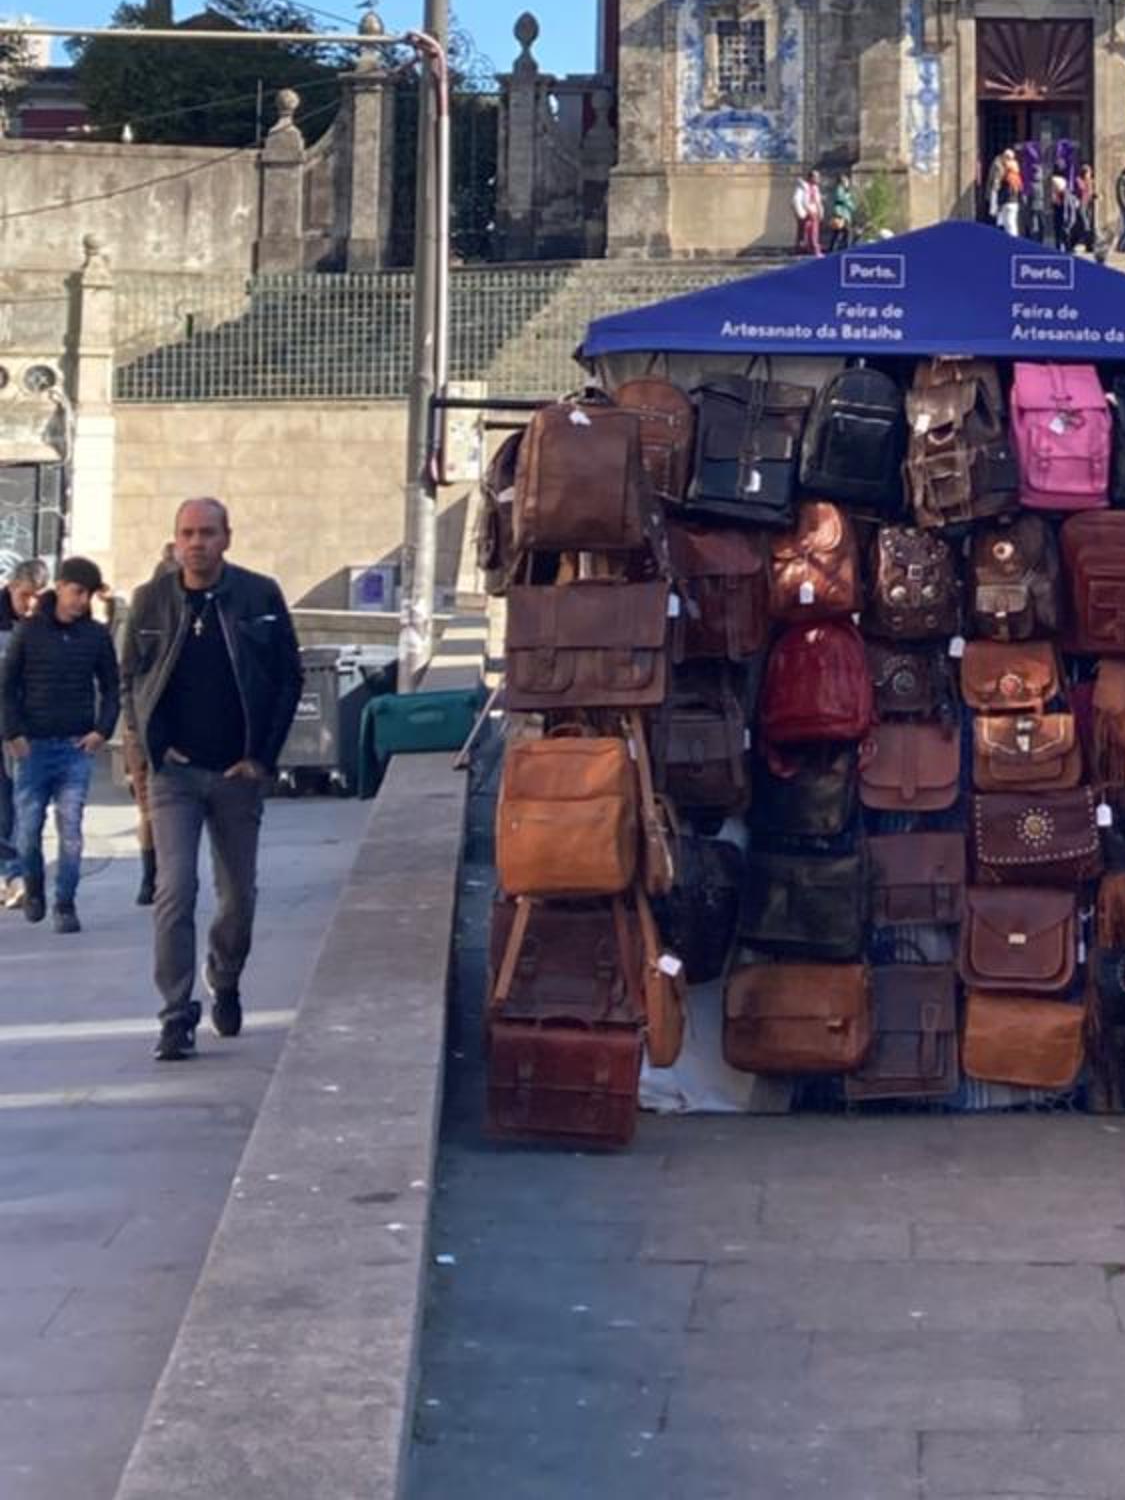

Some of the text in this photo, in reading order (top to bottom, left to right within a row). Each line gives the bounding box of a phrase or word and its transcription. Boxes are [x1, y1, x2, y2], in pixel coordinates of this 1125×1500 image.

[849, 263, 896, 279] Porto.
[1020, 264, 1065, 280] Porto.
[836, 302, 904, 318] Feira de
[1011, 303, 1079, 320] Feira de
[721, 321, 903, 340] Artesanato da Batalha
[1011, 324, 1100, 341] Artesanato
[1104, 327, 1125, 342] da
